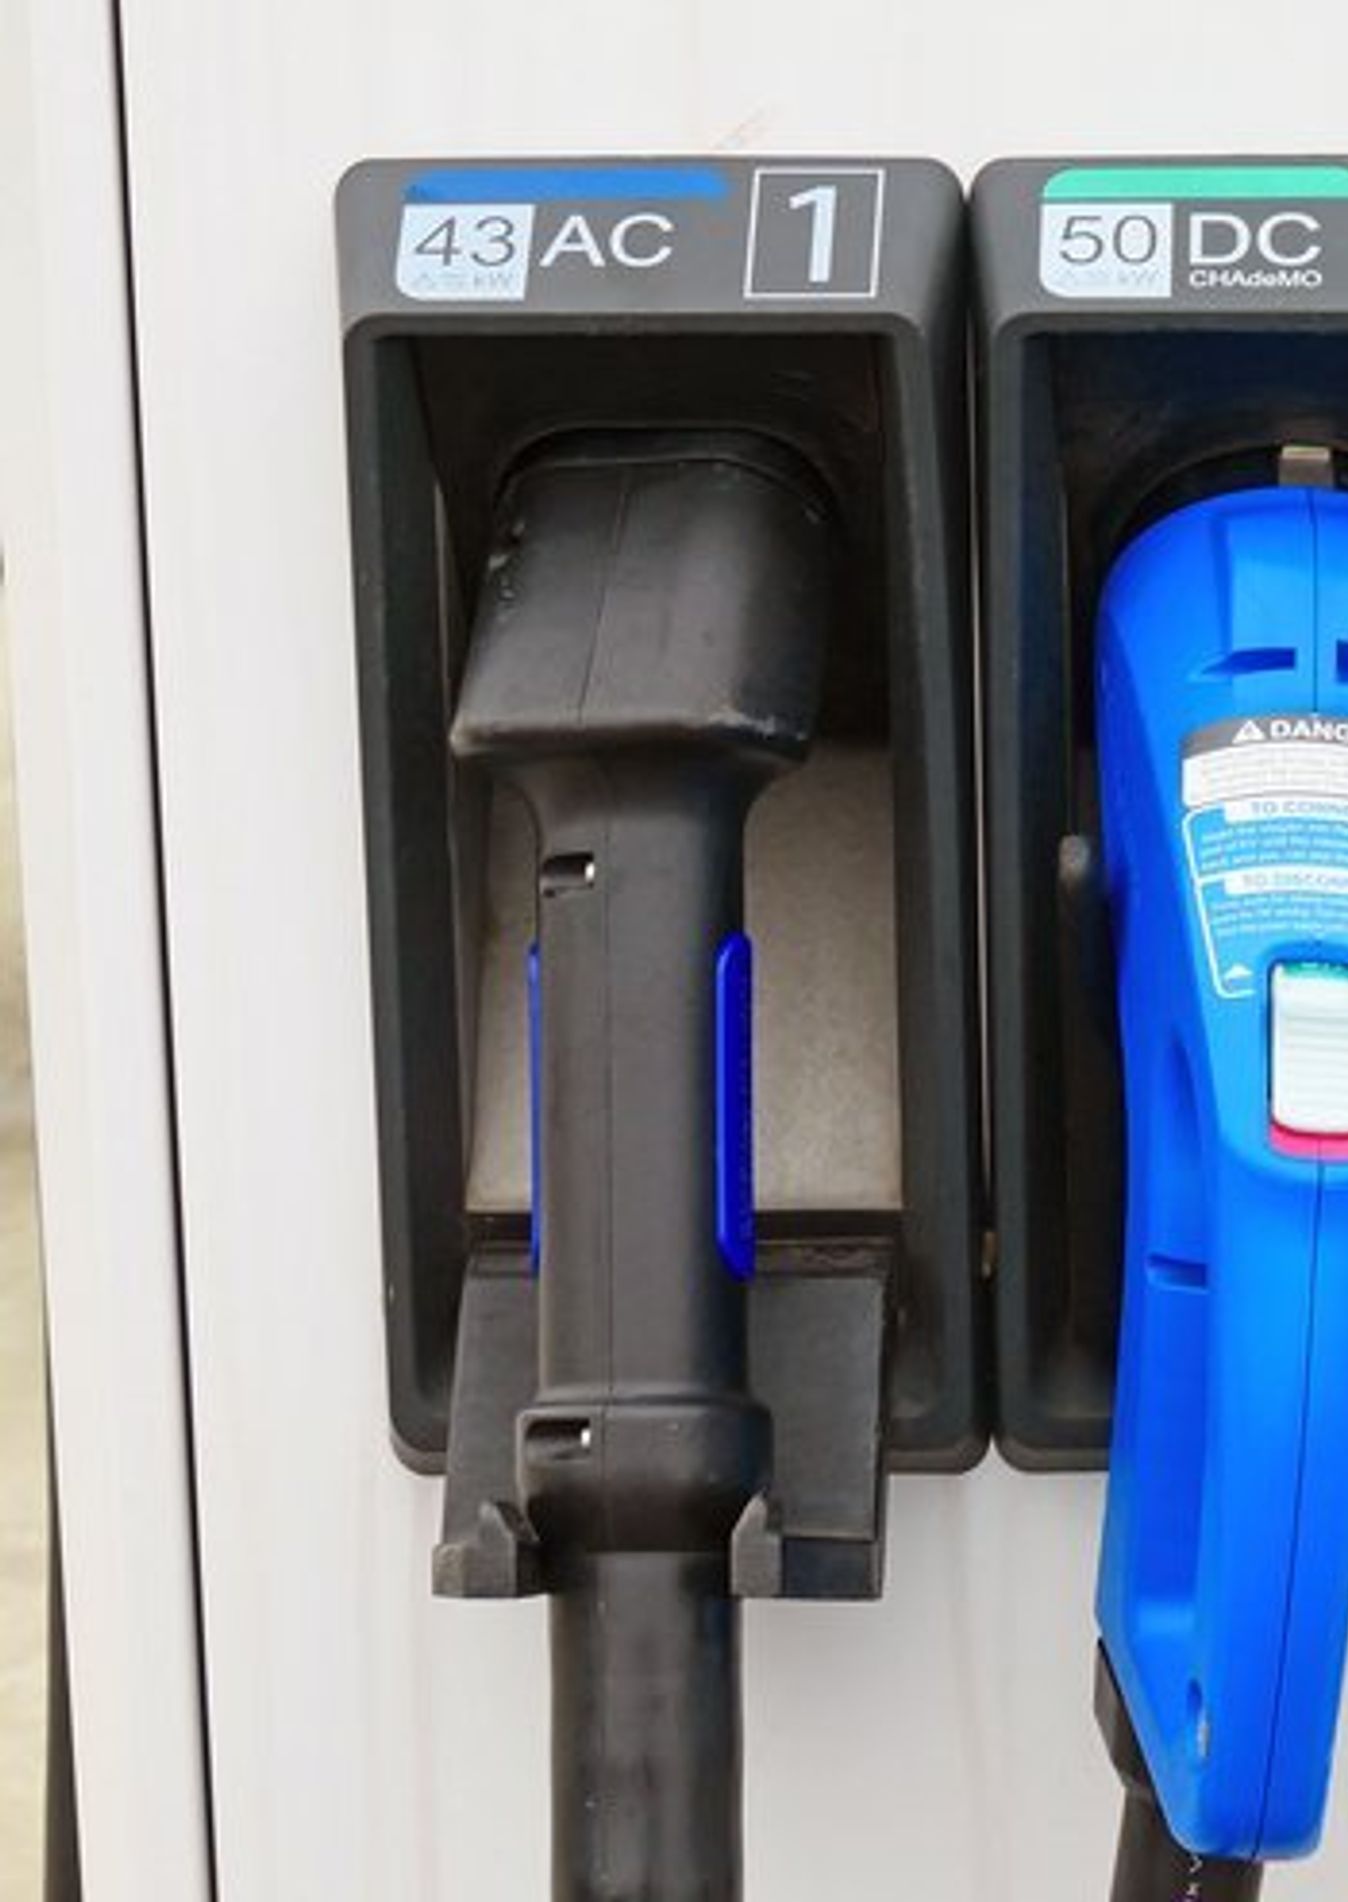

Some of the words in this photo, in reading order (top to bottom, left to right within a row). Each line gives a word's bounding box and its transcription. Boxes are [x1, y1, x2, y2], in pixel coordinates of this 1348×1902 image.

[414, 215, 516, 267] 43
[539, 213, 676, 267] AC
[788, 185, 838, 283] 1
[1058, 214, 1158, 264] 50
[1188, 210, 1323, 266] DC
[1189, 269, 1323, 289] CHAdeMO
